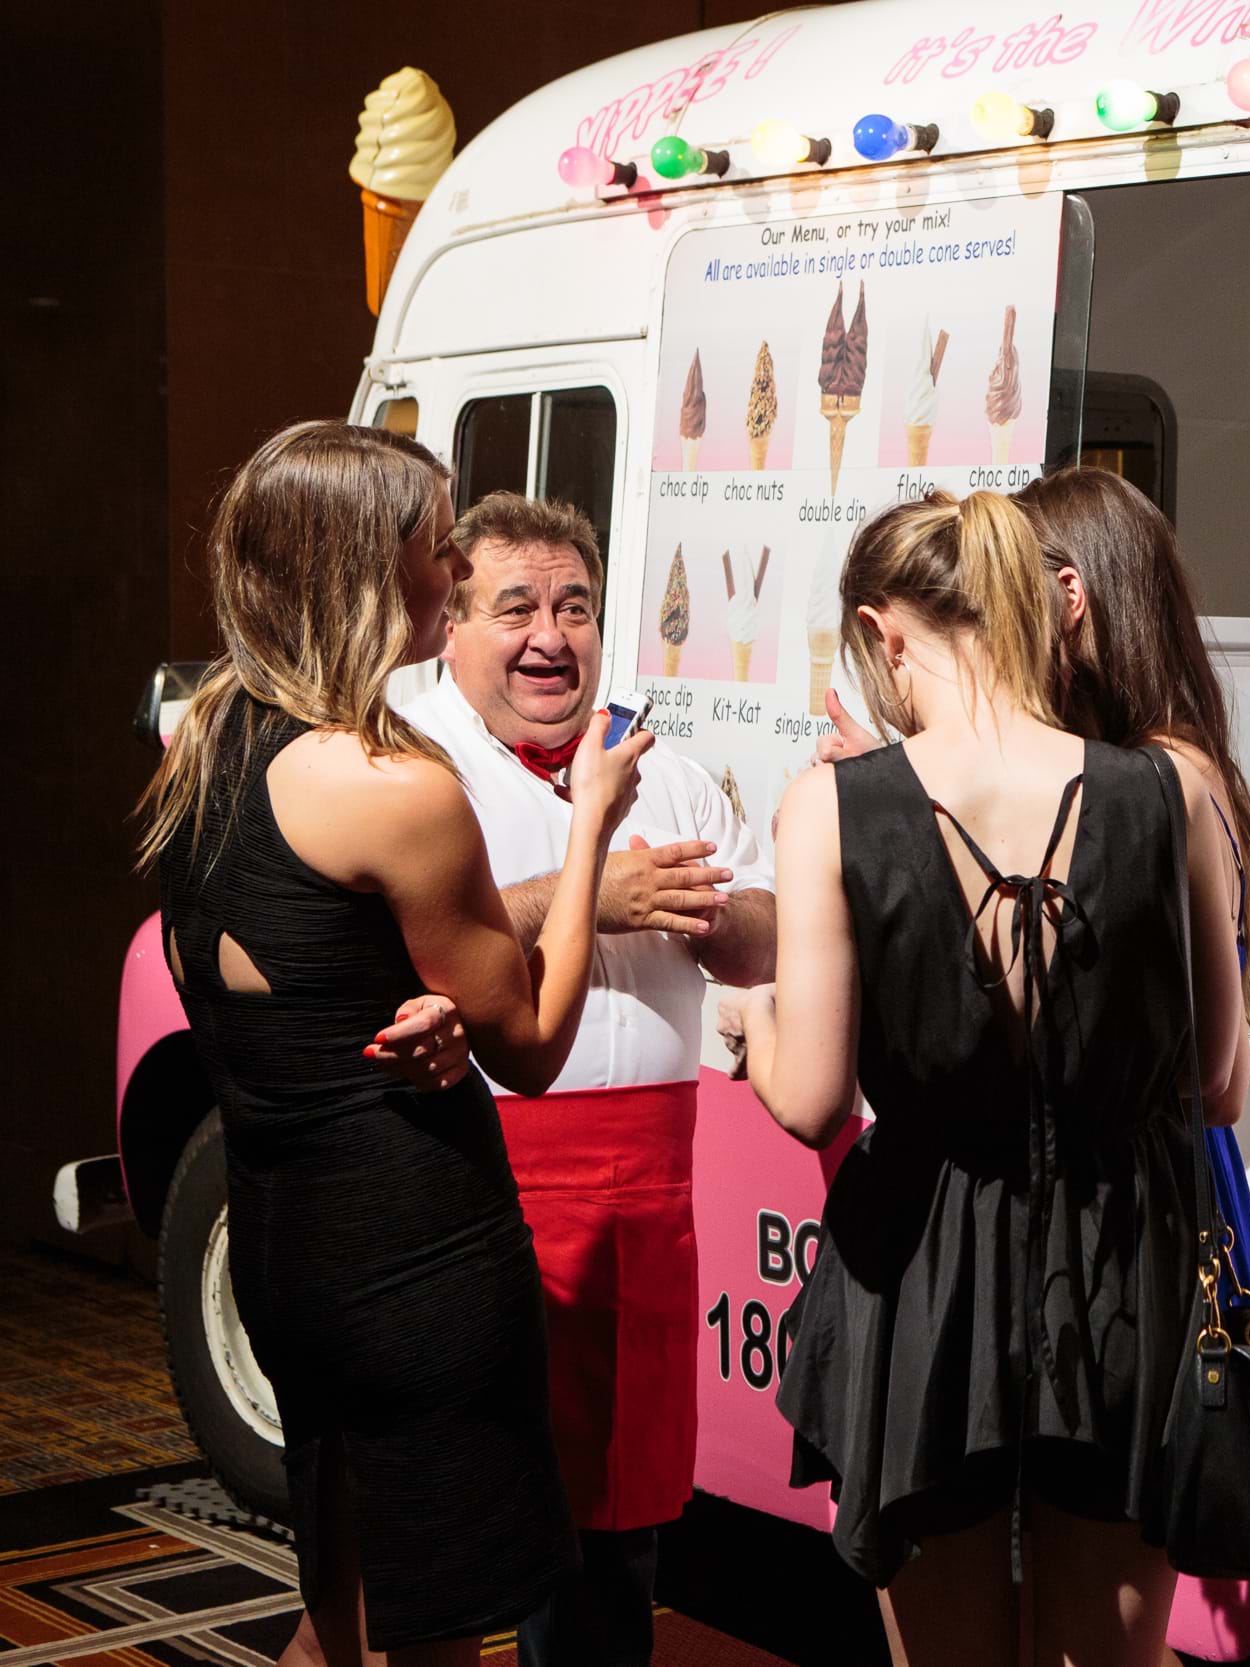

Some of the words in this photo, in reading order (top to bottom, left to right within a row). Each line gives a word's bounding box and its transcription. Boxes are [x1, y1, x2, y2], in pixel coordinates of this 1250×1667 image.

[992, 14, 1098, 73] the
[761, 227, 785, 246] Our
[791, 225, 829, 243] Menu,
[837, 225, 851, 239] or
[858, 219, 879, 241] try
[885, 217, 916, 239] your
[922, 207, 951, 231] mix!
[704, 258, 720, 282] All
[723, 263, 742, 280] are
[746, 252, 800, 279] available
[804, 252, 815, 275] in
[819, 247, 856, 279] single
[860, 254, 875, 270] or
[879, 239, 923, 268] double
[928, 243, 960, 264] cone
[964, 229, 1016, 261] serves!
[660, 473, 687, 497] choc
[690, 473, 709, 504] dip
[724, 477, 752, 501] choc
[756, 480, 784, 501] nuts
[897, 473, 935, 501] flake
[969, 465, 1002, 487] choc
[1007, 465, 1030, 489] dip
[799, 498, 842, 522] double
[846, 498, 866, 526] dip
[645, 682, 671, 706] choc
[674, 683, 693, 714] dip
[712, 697, 761, 724] Kit-Kat
[646, 712, 694, 738] reckles
[774, 712, 812, 743] single
